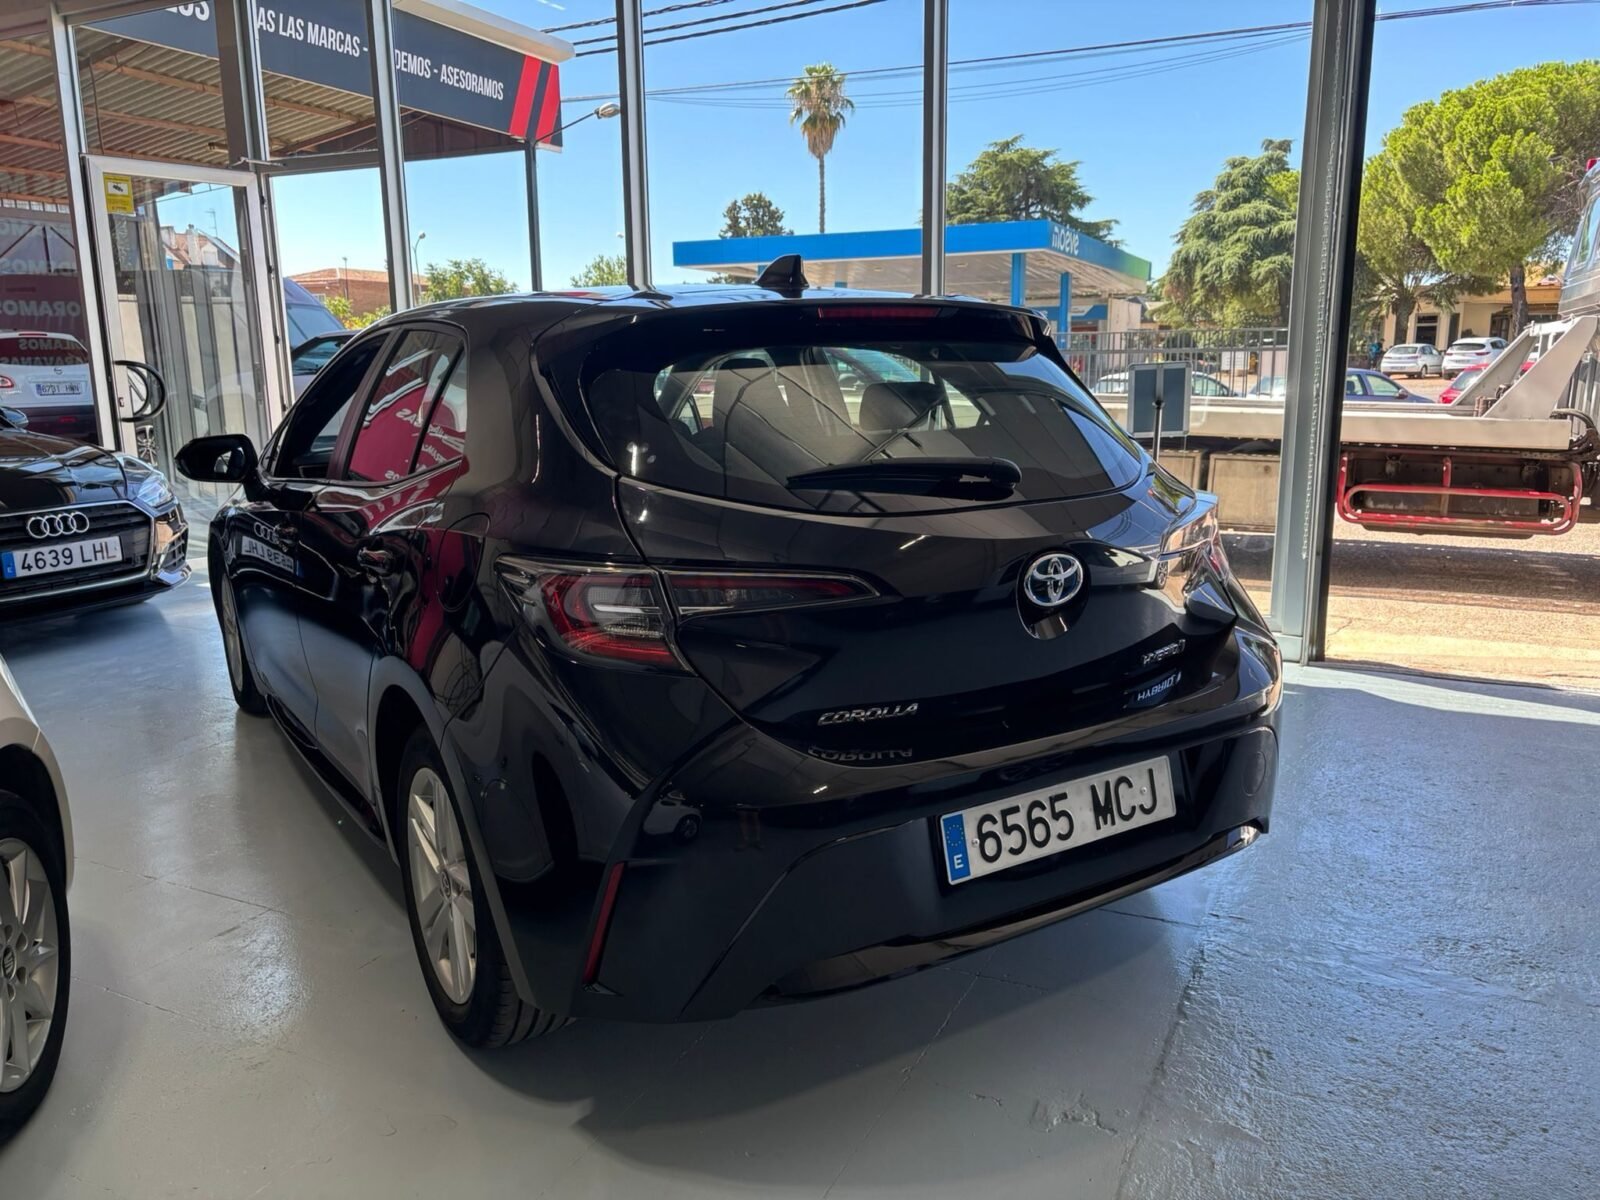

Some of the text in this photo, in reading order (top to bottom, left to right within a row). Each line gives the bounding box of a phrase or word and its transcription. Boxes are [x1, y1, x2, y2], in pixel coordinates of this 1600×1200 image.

[279, 13, 305, 41] LAS
[307, 21, 361, 58] MARCAS
[440, 64, 504, 101] ASESORAMOS
[21, 547, 74, 572] 4639
[80, 541, 117, 563] LHL
[817, 702, 919, 727] COROLLA
[953, 768, 1158, 870] E 6565 MCJ
